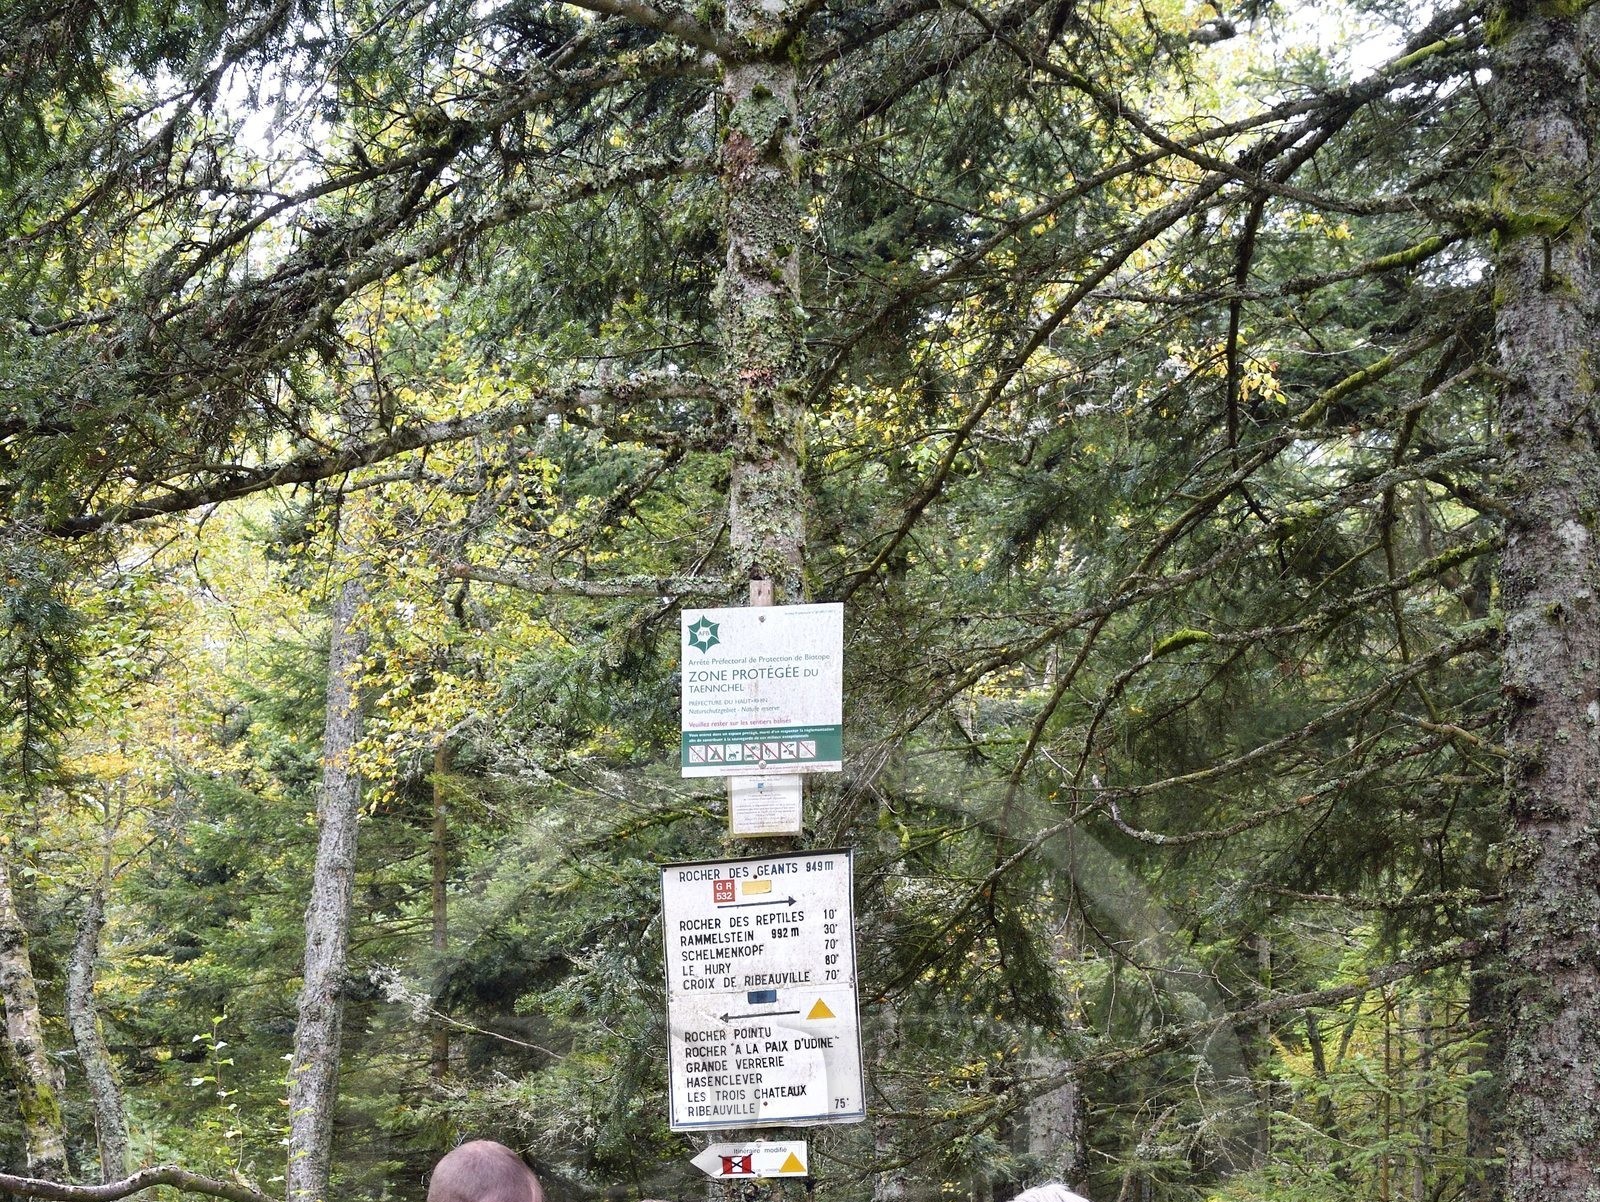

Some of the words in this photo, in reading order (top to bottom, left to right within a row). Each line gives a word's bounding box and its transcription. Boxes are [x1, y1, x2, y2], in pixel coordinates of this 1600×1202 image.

[805, 653, 830, 662] Biotope
[689, 670, 727, 682] ZONE
[732, 664, 799, 680] PROTÉGÉE
[804, 668, 818, 677] DU
[689, 684, 744, 693] TAENNCHEL
[679, 869, 721, 882] ROCHER
[729, 867, 749, 878] DES
[757, 863, 798, 876] GEANTS
[680, 918, 721, 931] ROCHER
[730, 916, 749, 928] DES
[756, 911, 804, 926] REPTILES
[680, 930, 754, 946] RAMMELSTEIN
[682, 944, 764, 961] SCHELMENKOPF
[682, 966, 694, 976] LE
[704, 963, 731, 975] HURY
[683, 978, 715, 990] CROIX
[724, 977, 736, 988] DE
[744, 971, 810, 986] RIBEAUVILLE
[685, 1030, 726, 1042] ROCHER
[734, 1027, 771, 1040] POINTU
[685, 1046, 727, 1058] ROCHER
[746, 1043, 759, 1054] LA
[765, 1041, 788, 1052] PAIX
[686, 1060, 728, 1073] GRANDE
[735, 1056, 784, 1070] VERRERIE
[687, 1073, 763, 1088] HASENCLEVER
[687, 1092, 706, 1102] LES
[716, 1089, 746, 1101] TROIS
[754, 1085, 806, 1099] CHATEAUX
[688, 1103, 755, 1117] RIBEAUVILLE
